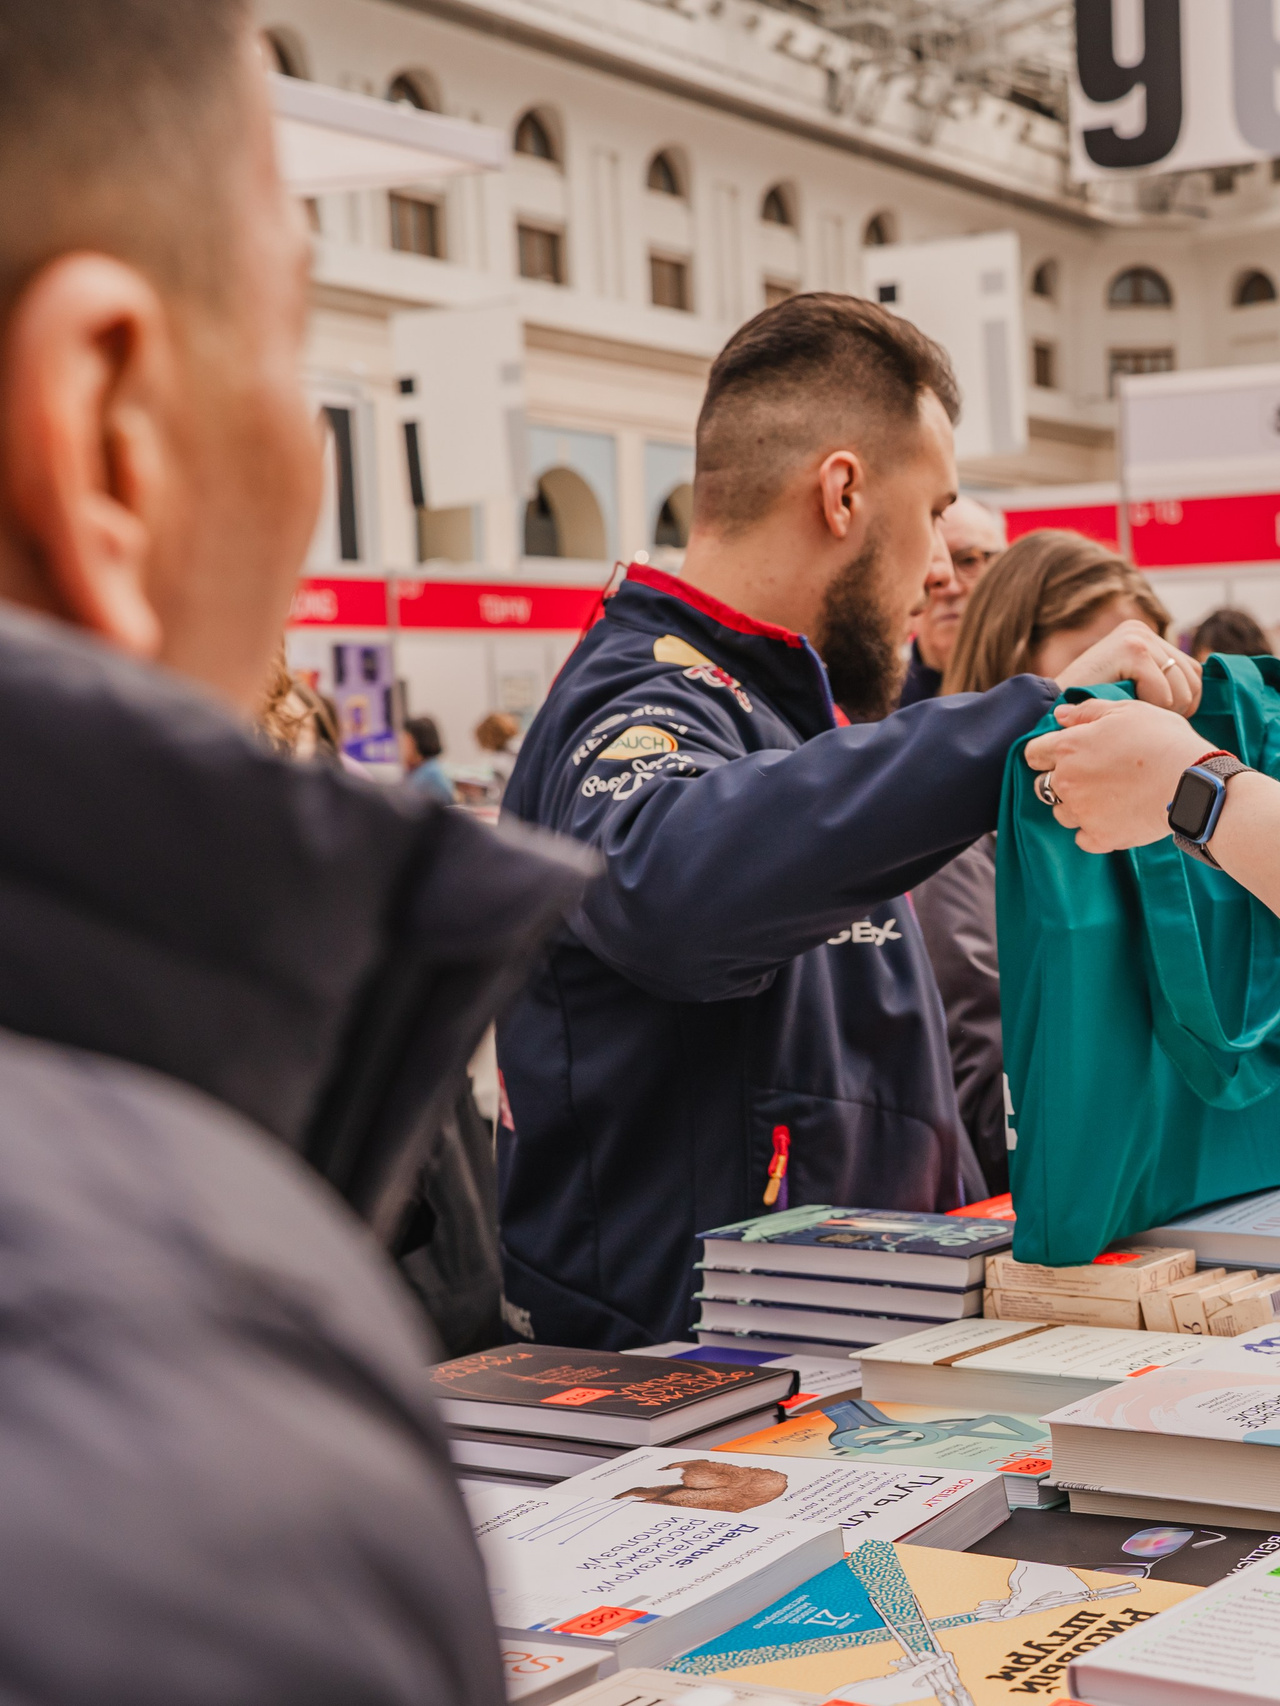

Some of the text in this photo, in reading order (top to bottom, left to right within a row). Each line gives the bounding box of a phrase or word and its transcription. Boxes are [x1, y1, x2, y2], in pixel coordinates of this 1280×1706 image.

[610, 736, 665, 751] AUCH
[872, 1473, 945, 1508] Путь
[575, 1516, 685, 1570] используй
[581, 1521, 732, 1594] визуализируй,
[669, 1523, 760, 1569] Данные:
[802, 1608, 851, 1627] 21
[985, 1610, 1107, 1682] штурм
[1009, 1607, 1161, 1695] Рисовый
